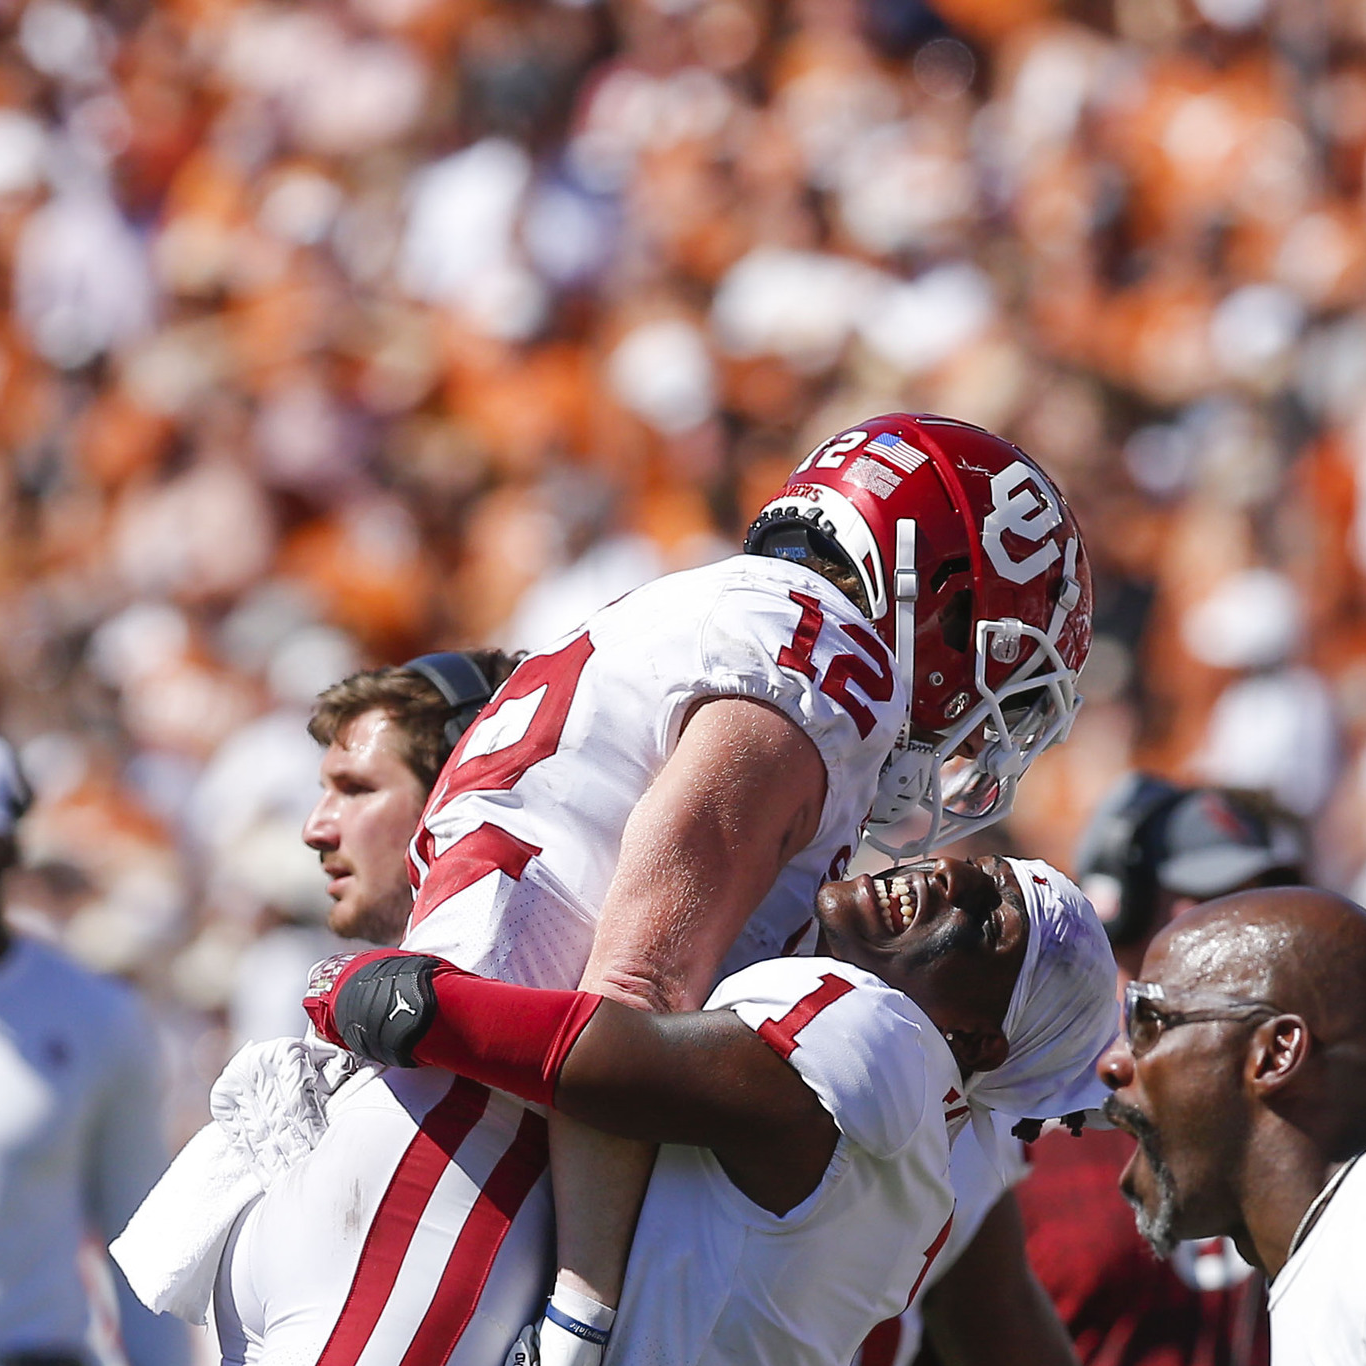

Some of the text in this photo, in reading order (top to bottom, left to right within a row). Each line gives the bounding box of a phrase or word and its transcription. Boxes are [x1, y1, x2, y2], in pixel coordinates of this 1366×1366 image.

[796, 430, 869, 475] 12
[981, 460, 1063, 586] OU
[777, 589, 895, 742] 12
[757, 972, 857, 1061] 1
